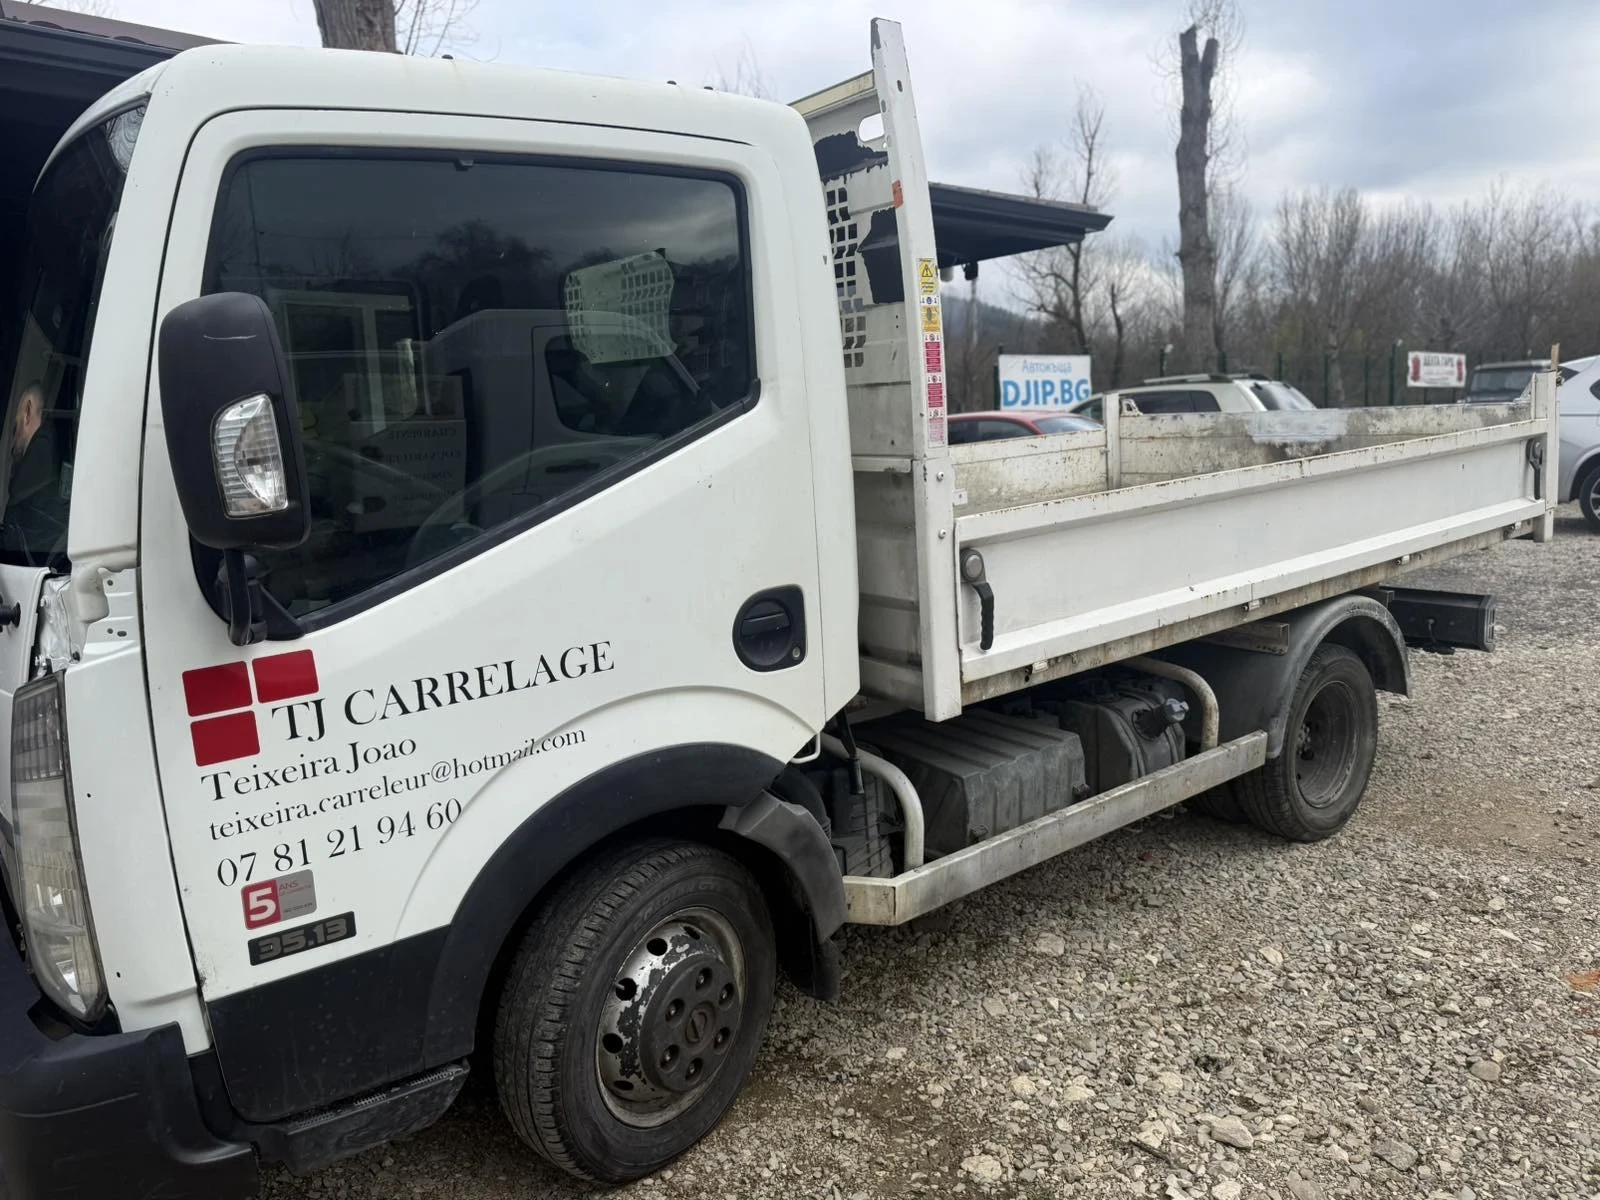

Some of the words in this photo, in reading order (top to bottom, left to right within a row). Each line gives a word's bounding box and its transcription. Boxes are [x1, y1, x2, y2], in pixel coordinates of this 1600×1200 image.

[1002, 378, 1090, 407] DJIP.BG
[1021, 360, 1072, 375] Автокъща
[271, 697, 327, 743] TJ
[343, 640, 616, 727] CARRELAGE
[200, 753, 341, 801] Teixeira
[346, 737, 418, 773] Joao
[209, 728, 587, 842] teixeira.carreleur@hotmail.com
[217, 852, 257, 887] 07
[273, 838, 311, 872] 81
[326, 825, 364, 859] 21
[377, 809, 417, 844] 94
[426, 798, 463, 830] 60
[248, 886, 277, 922] 5
[257, 917, 349, 961] 35.13
